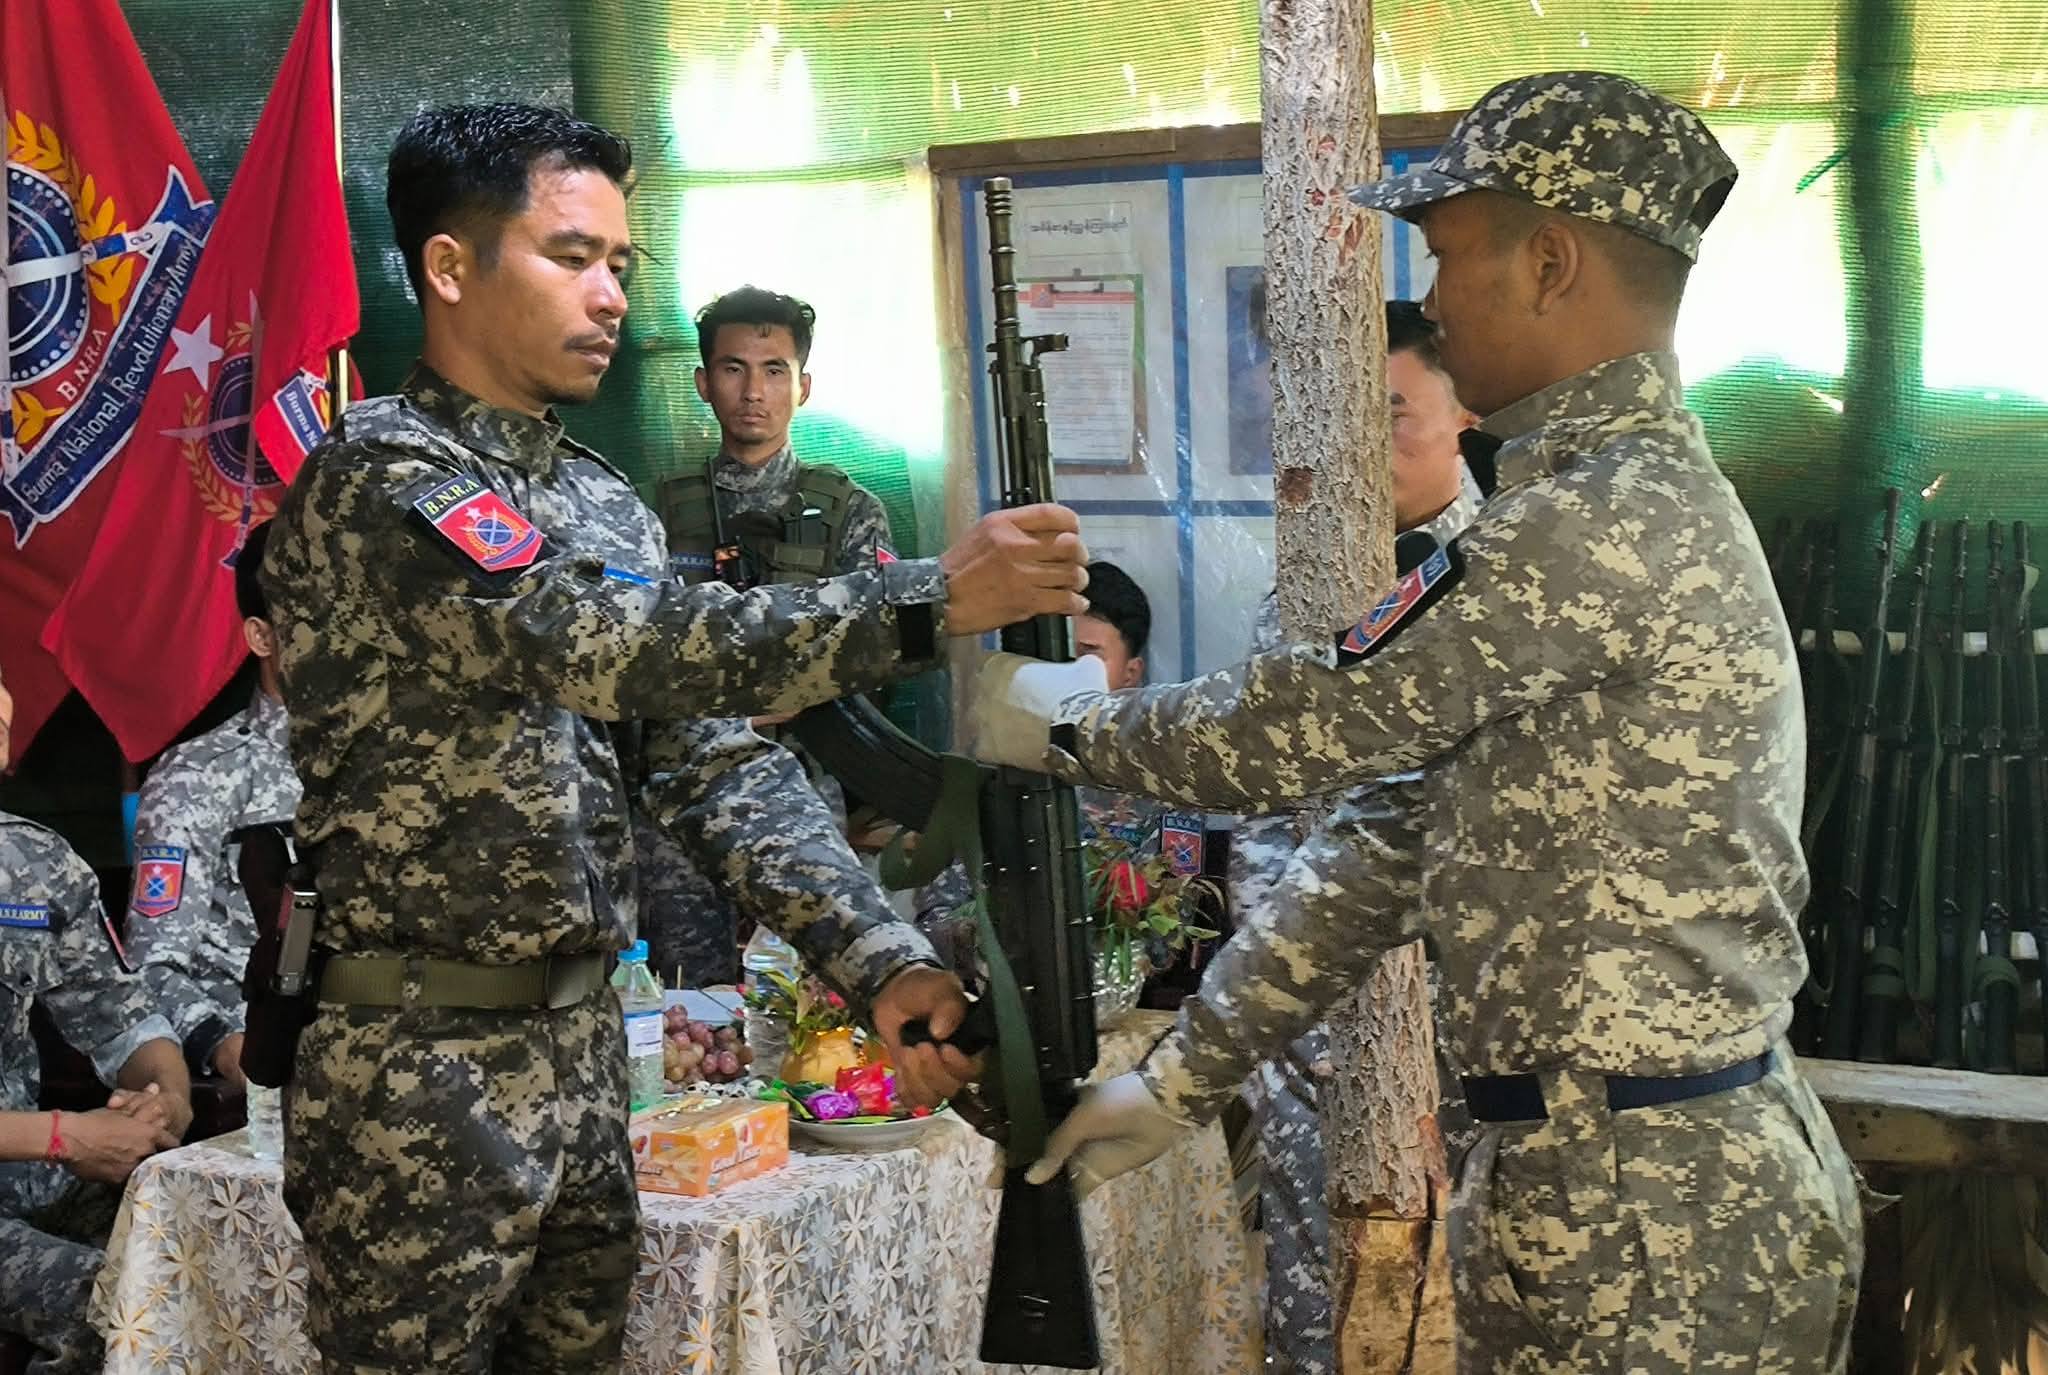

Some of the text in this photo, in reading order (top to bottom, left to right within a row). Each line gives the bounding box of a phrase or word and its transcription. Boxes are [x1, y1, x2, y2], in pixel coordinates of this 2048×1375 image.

[58, 391, 125, 462] National
[111, 279, 183, 397] Revolutionary
[165, 238, 197, 286] Army
[286, 389, 311, 433] Burma
[423, 478, 480, 515] B.N.R.A
